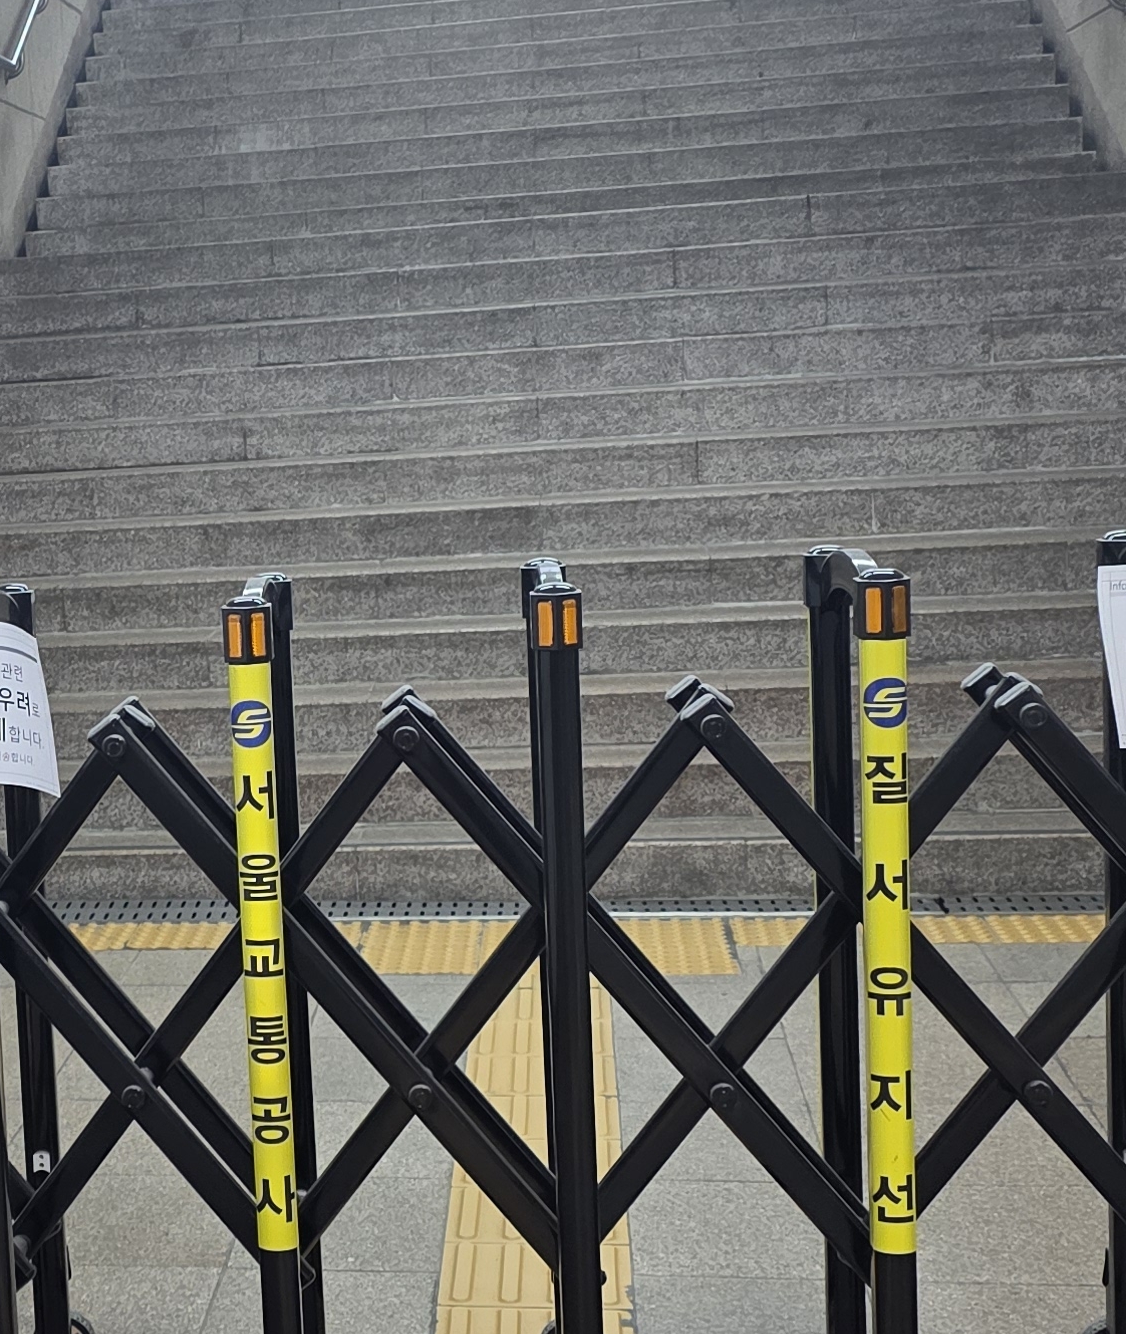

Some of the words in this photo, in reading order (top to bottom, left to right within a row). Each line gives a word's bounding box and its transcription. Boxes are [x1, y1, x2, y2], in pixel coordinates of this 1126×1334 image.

[0, 662, 24, 682] 관련
[236, 771, 297, 1224] 서울교통공사
[864, 752, 915, 1224] 질서유지선
